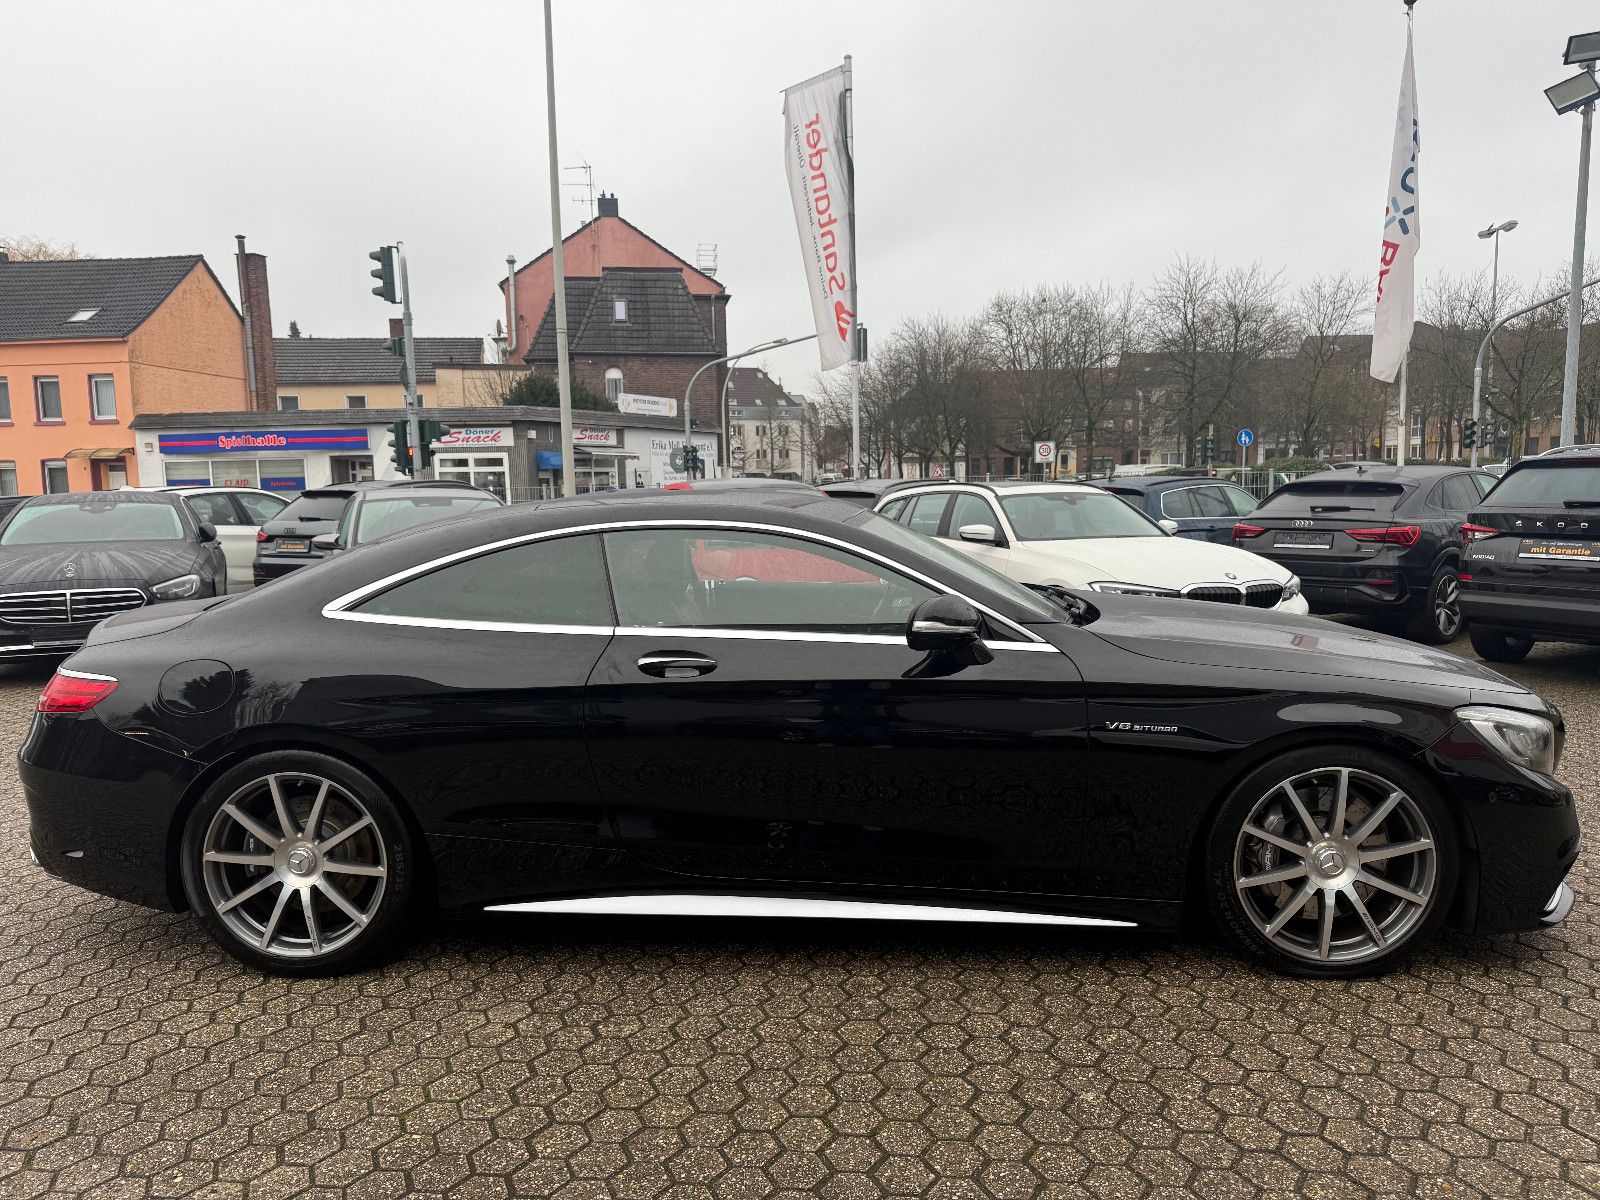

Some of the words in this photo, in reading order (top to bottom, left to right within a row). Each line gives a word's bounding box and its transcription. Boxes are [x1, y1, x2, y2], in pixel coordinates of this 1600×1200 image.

[438, 430, 502, 443] Snack
[574, 428, 611, 441] Snack
[218, 434, 287, 449] Spielhalle
[1548, 547, 1591, 556] Garantie
[1132, 724, 1178, 732] BITURBO
